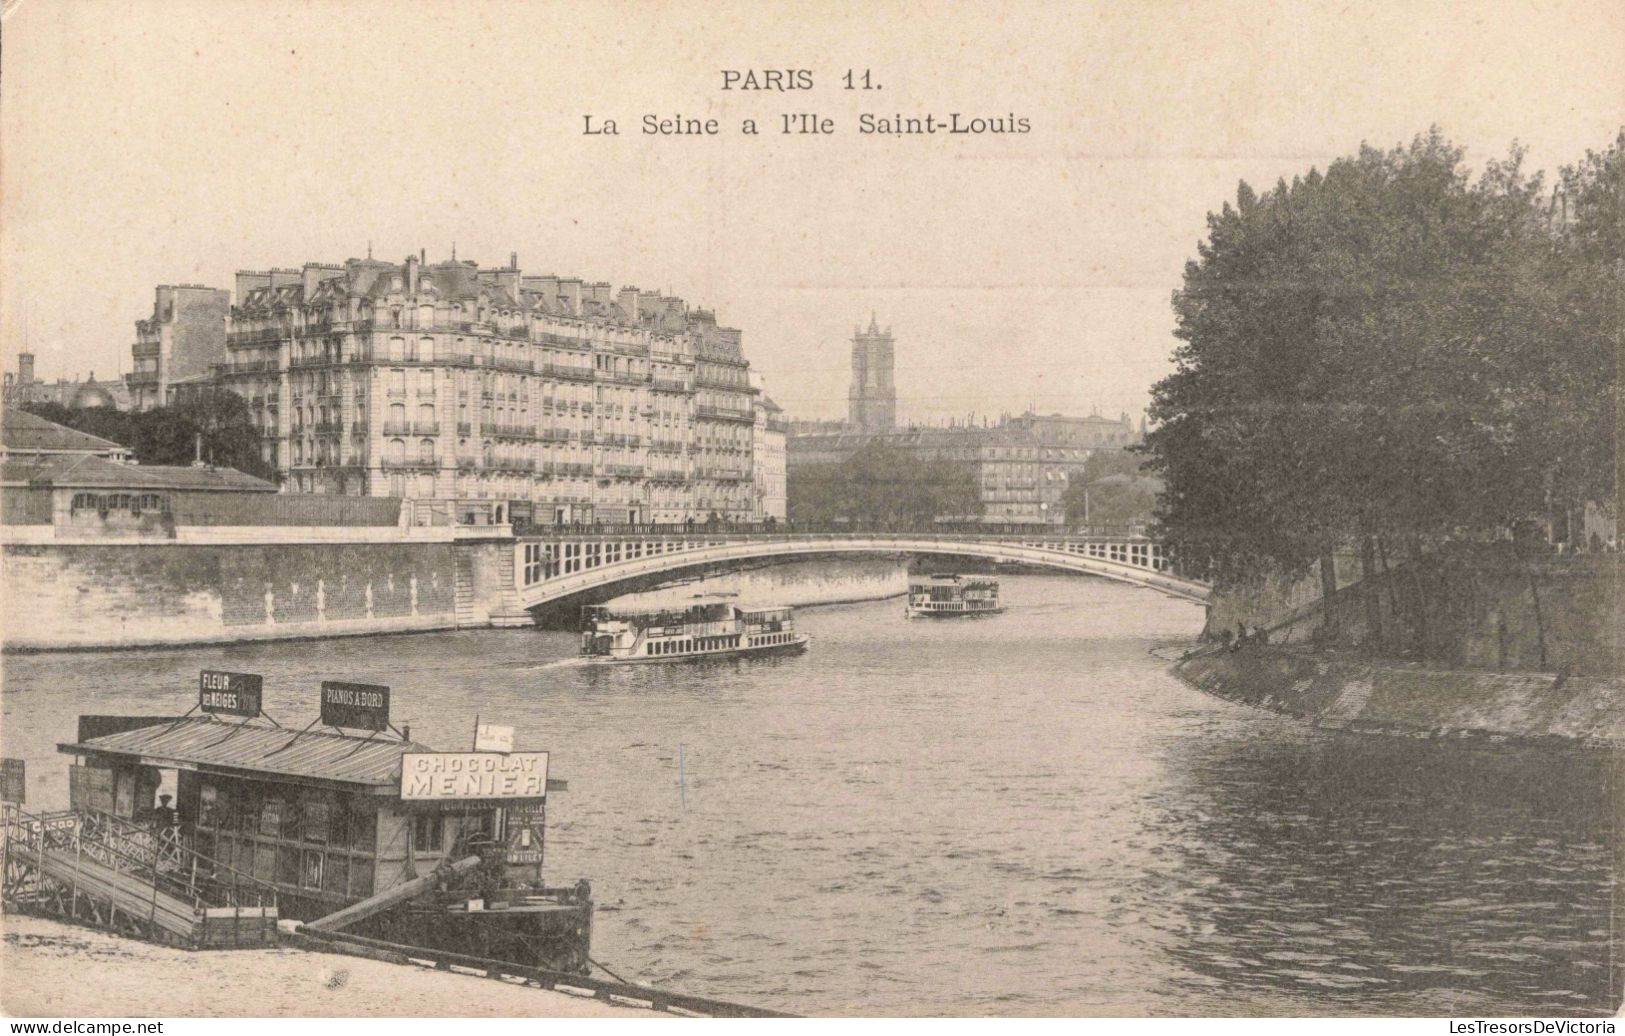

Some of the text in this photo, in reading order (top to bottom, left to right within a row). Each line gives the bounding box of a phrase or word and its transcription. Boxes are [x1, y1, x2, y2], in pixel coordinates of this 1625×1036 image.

[721, 69, 882, 92] PARIS 11.
[583, 115, 619, 135] La
[643, 114, 719, 135] Seine
[742, 120, 759, 135] a
[859, 113, 1031, 136] Saint-Louis
[203, 673, 230, 690] FLEUR
[211, 692, 237, 709] NEIGES
[327, 689, 353, 705] PIANOS
[361, 692, 383, 708] BORD
[417, 756, 537, 773] CHOCOLAT
[407, 774, 542, 796] MENIER
